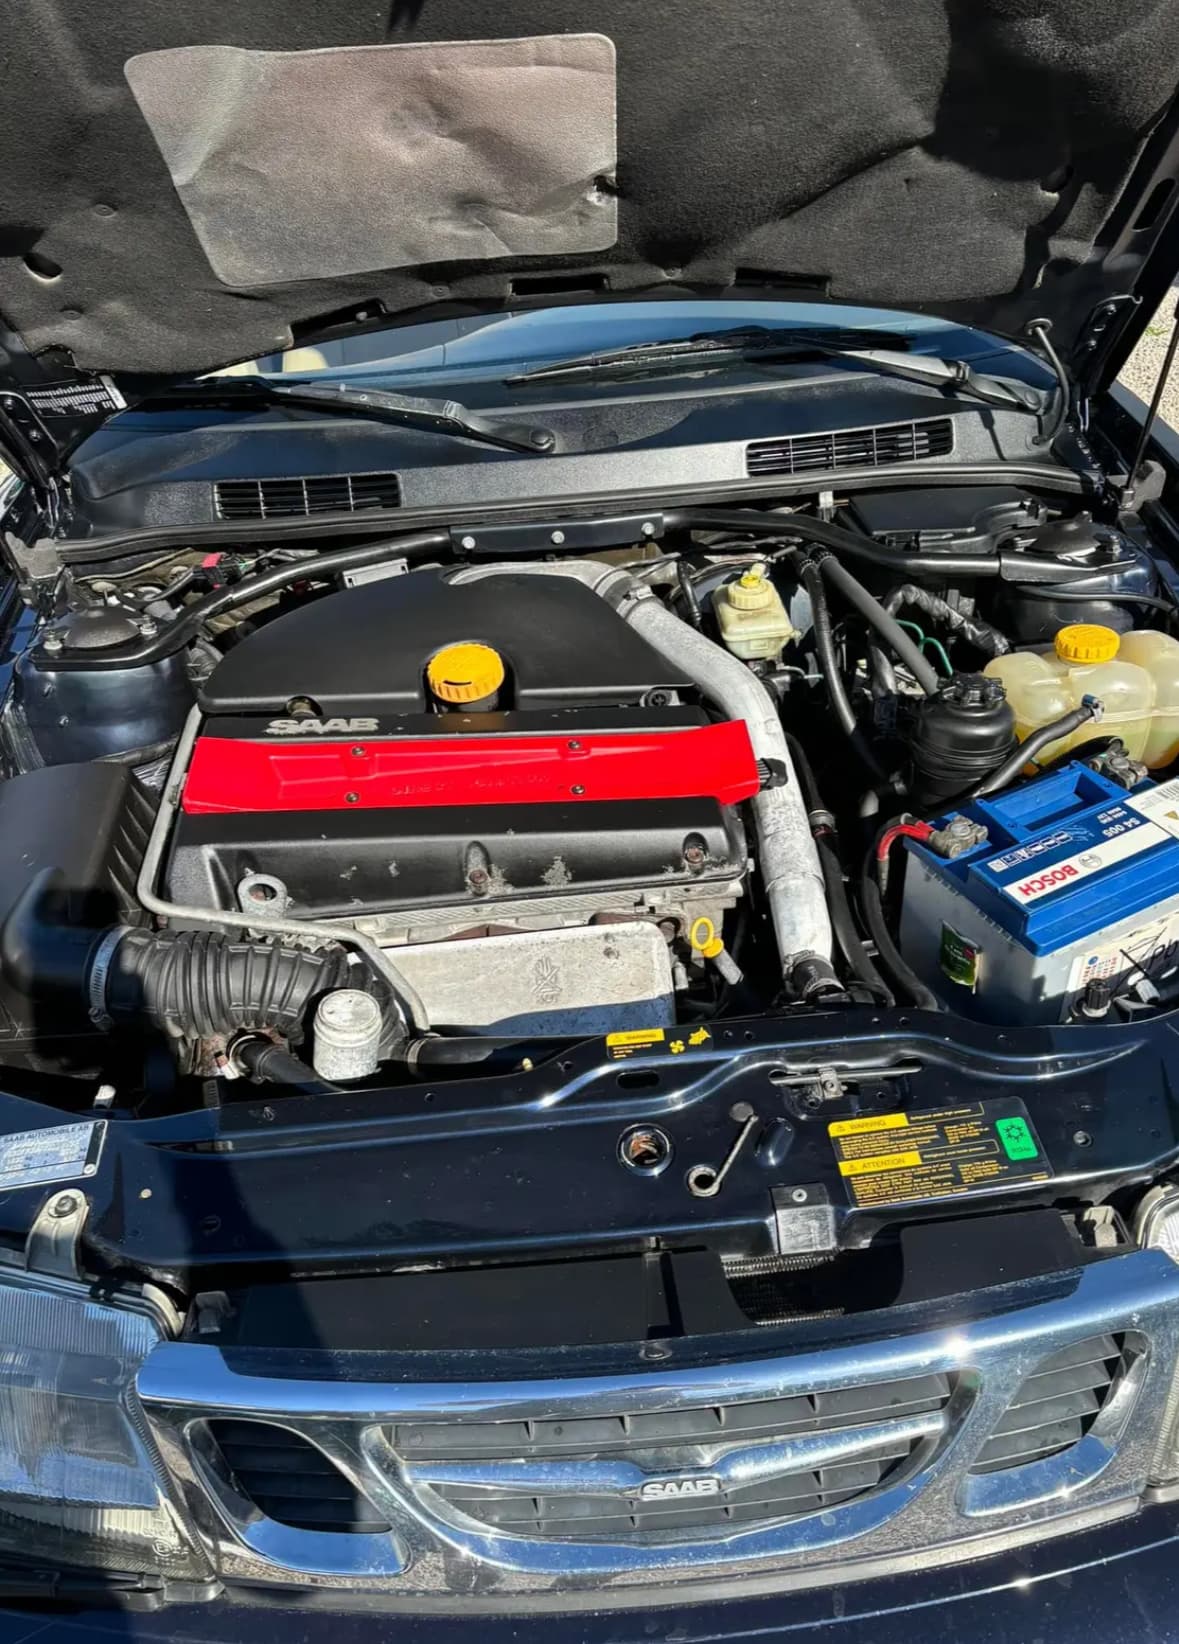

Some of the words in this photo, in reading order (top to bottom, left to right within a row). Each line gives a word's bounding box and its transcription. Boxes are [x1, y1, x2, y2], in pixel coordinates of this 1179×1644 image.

[264, 717, 380, 735] SAAB
[1018, 864, 1080, 898] BOSCH
[862, 1157, 905, 1170] ATTENTION
[642, 1479, 719, 1501] SAAB
